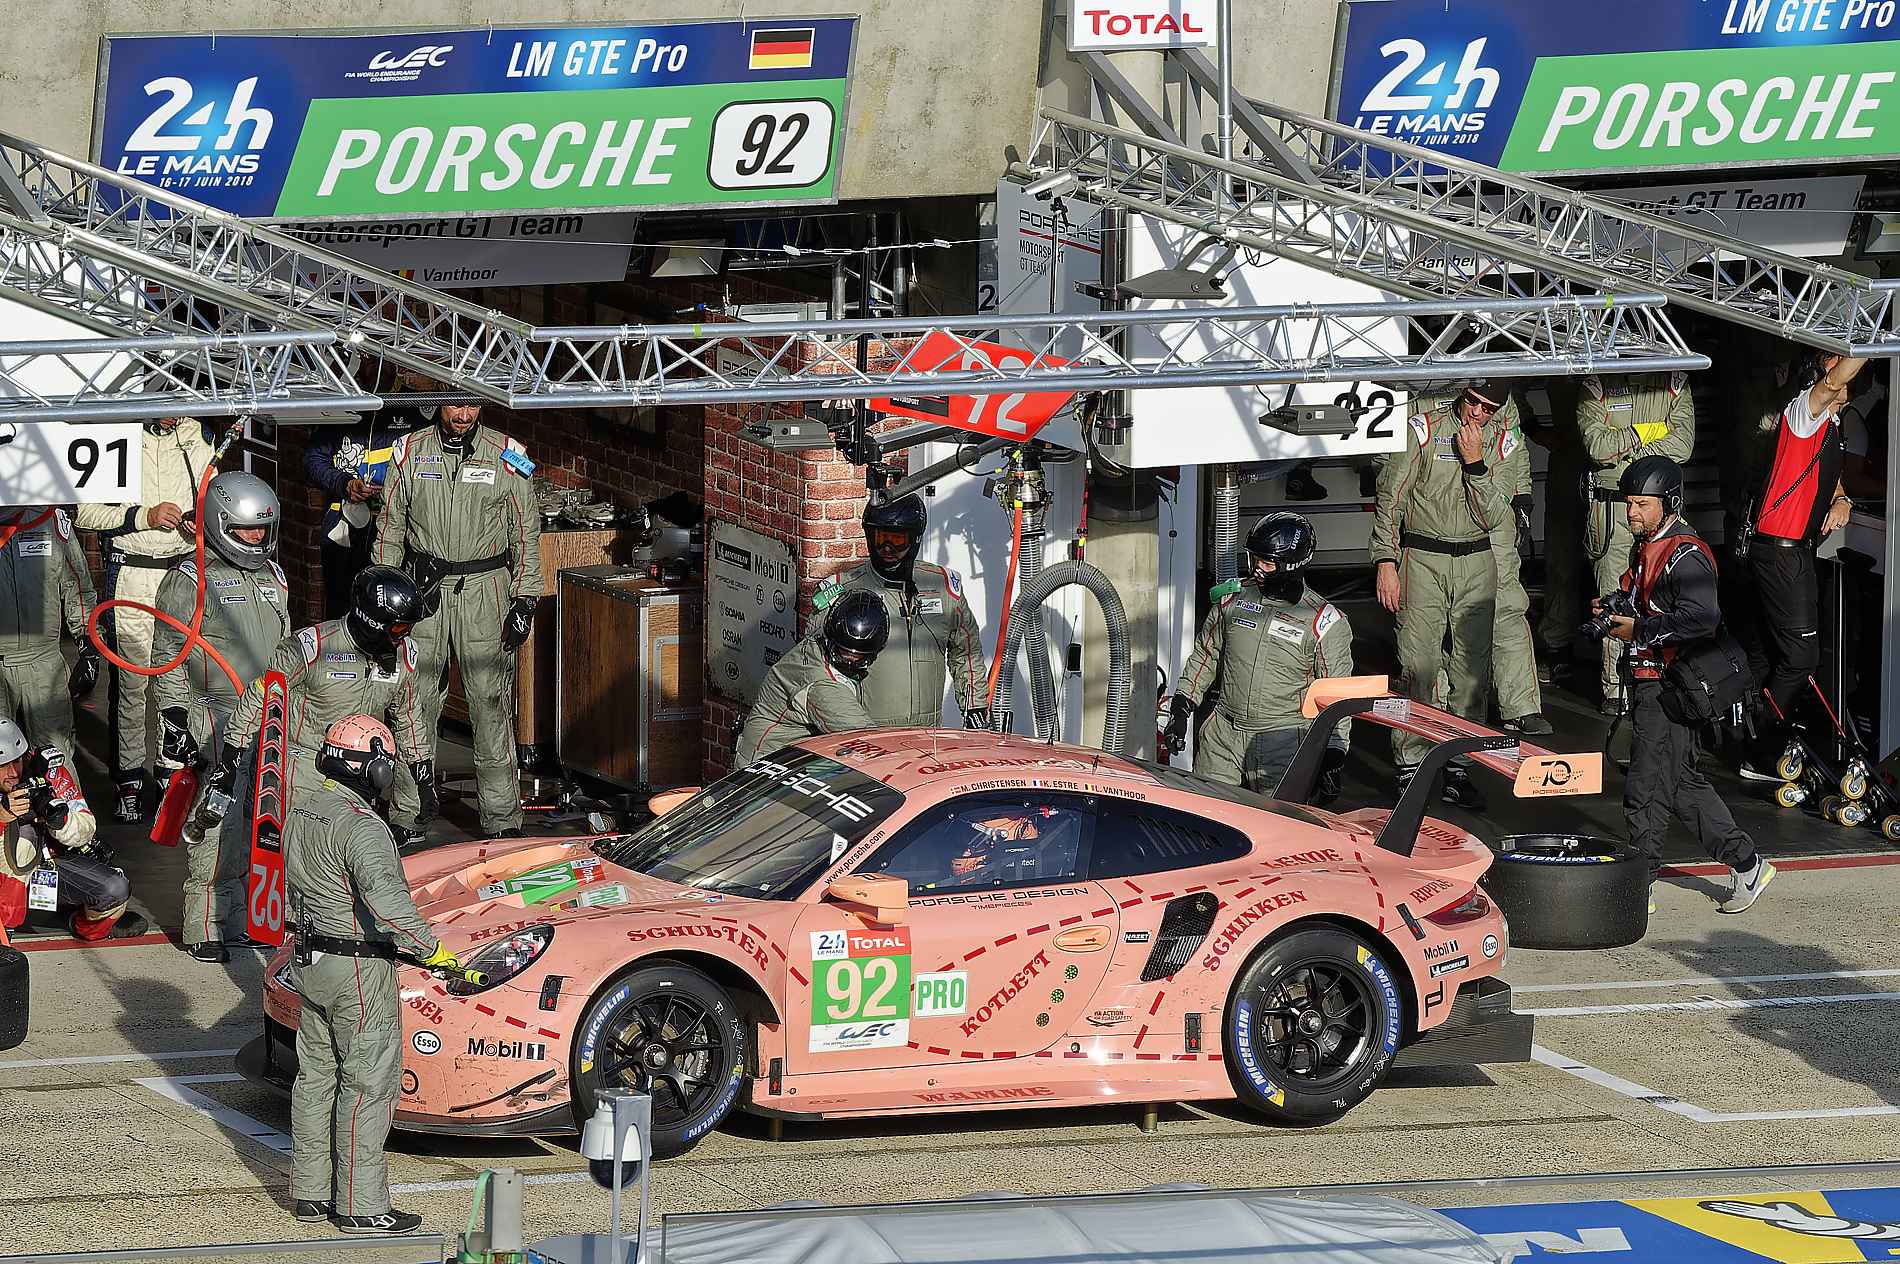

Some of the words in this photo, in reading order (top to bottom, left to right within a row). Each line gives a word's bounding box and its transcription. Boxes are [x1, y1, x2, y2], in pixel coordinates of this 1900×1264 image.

[1084, 10, 1203, 36] TOTAL
[1721, 0, 1771, 35] LM
[1776, 0, 1839, 33] GTE
[1841, 0, 1895, 30] Pro
[369, 46, 454, 71] WEC
[506, 42, 558, 78] LM
[563, 40, 630, 77] GTE
[631, 38, 689, 74] Pro
[370, 75, 418, 83] CHAMPIONSHIP
[1360, 37, 1501, 112] 24h
[125, 77, 274, 151] 24h
[1537, 71, 1897, 154] PORSCHE
[1353, 116, 1389, 135] LE
[1396, 113, 1487, 134] MANS
[735, 112, 811, 177] 92
[1424, 133, 1450, 146] JUIN
[1452, 131, 1480, 145] 2018
[116, 156, 156, 175] LE
[163, 154, 260, 174] MANS
[316, 117, 693, 197] PORSCHE
[159, 176, 191, 188] 16-17
[194, 177, 222, 187] JUIN
[225, 175, 254, 187] 2018
[1685, 189, 1731, 210] GT
[1734, 189, 1807, 210] Team
[506, 214, 584, 236] Team
[1019, 209, 1100, 245] PORSCHE
[423, 266, 499, 284] Vanthoor
[1029, 259, 1047, 277] TEAM
[67, 438, 128, 489] 91
[414, 455, 435, 464] Mobil
[724, 549, 749, 565] MICHELIN
[754, 554, 780, 582] Mobil
[376, 584, 385, 608] uvex
[355, 607, 385, 631] uvex
[725, 606, 746, 623] SCANIA
[722, 628, 742, 646] OSRAM
[759, 619, 786, 641] RECARO
[1541, 760, 1572, 787] 70
[971, 779, 1027, 791] CHRISTENSEN
[1053, 781, 1079, 791] ESTRE
[1103, 786, 1147, 801] VANTHOOR
[824, 829, 886, 885] www.porsche.com
[908, 892, 1008, 909] PORSCHE
[1013, 887, 1089, 900] DESIGN
[971, 900, 1033, 911] TIMEPIECES
[1202, 889, 1309, 972] SCHINKEN
[626, 924, 770, 973] SCHULTER
[850, 936, 906, 950] TOTAL
[1424, 944, 1450, 960] Mobil
[1484, 941, 1497, 952] Esso
[826, 957, 898, 1020] 92
[917, 977, 965, 1011] PRO
[959, 949, 1052, 1039] KOTLETT
[584, 989, 626, 1048] MICHELIN
[1374, 968, 1398, 1047] MICHELIN
[417, 1035, 438, 1049] Esso
[837, 1023, 897, 1040] WEC
[468, 1037, 523, 1059] Mobil
[1238, 1009, 1267, 1086] MICHELIN
[912, 1086, 1057, 1104] WAMME
